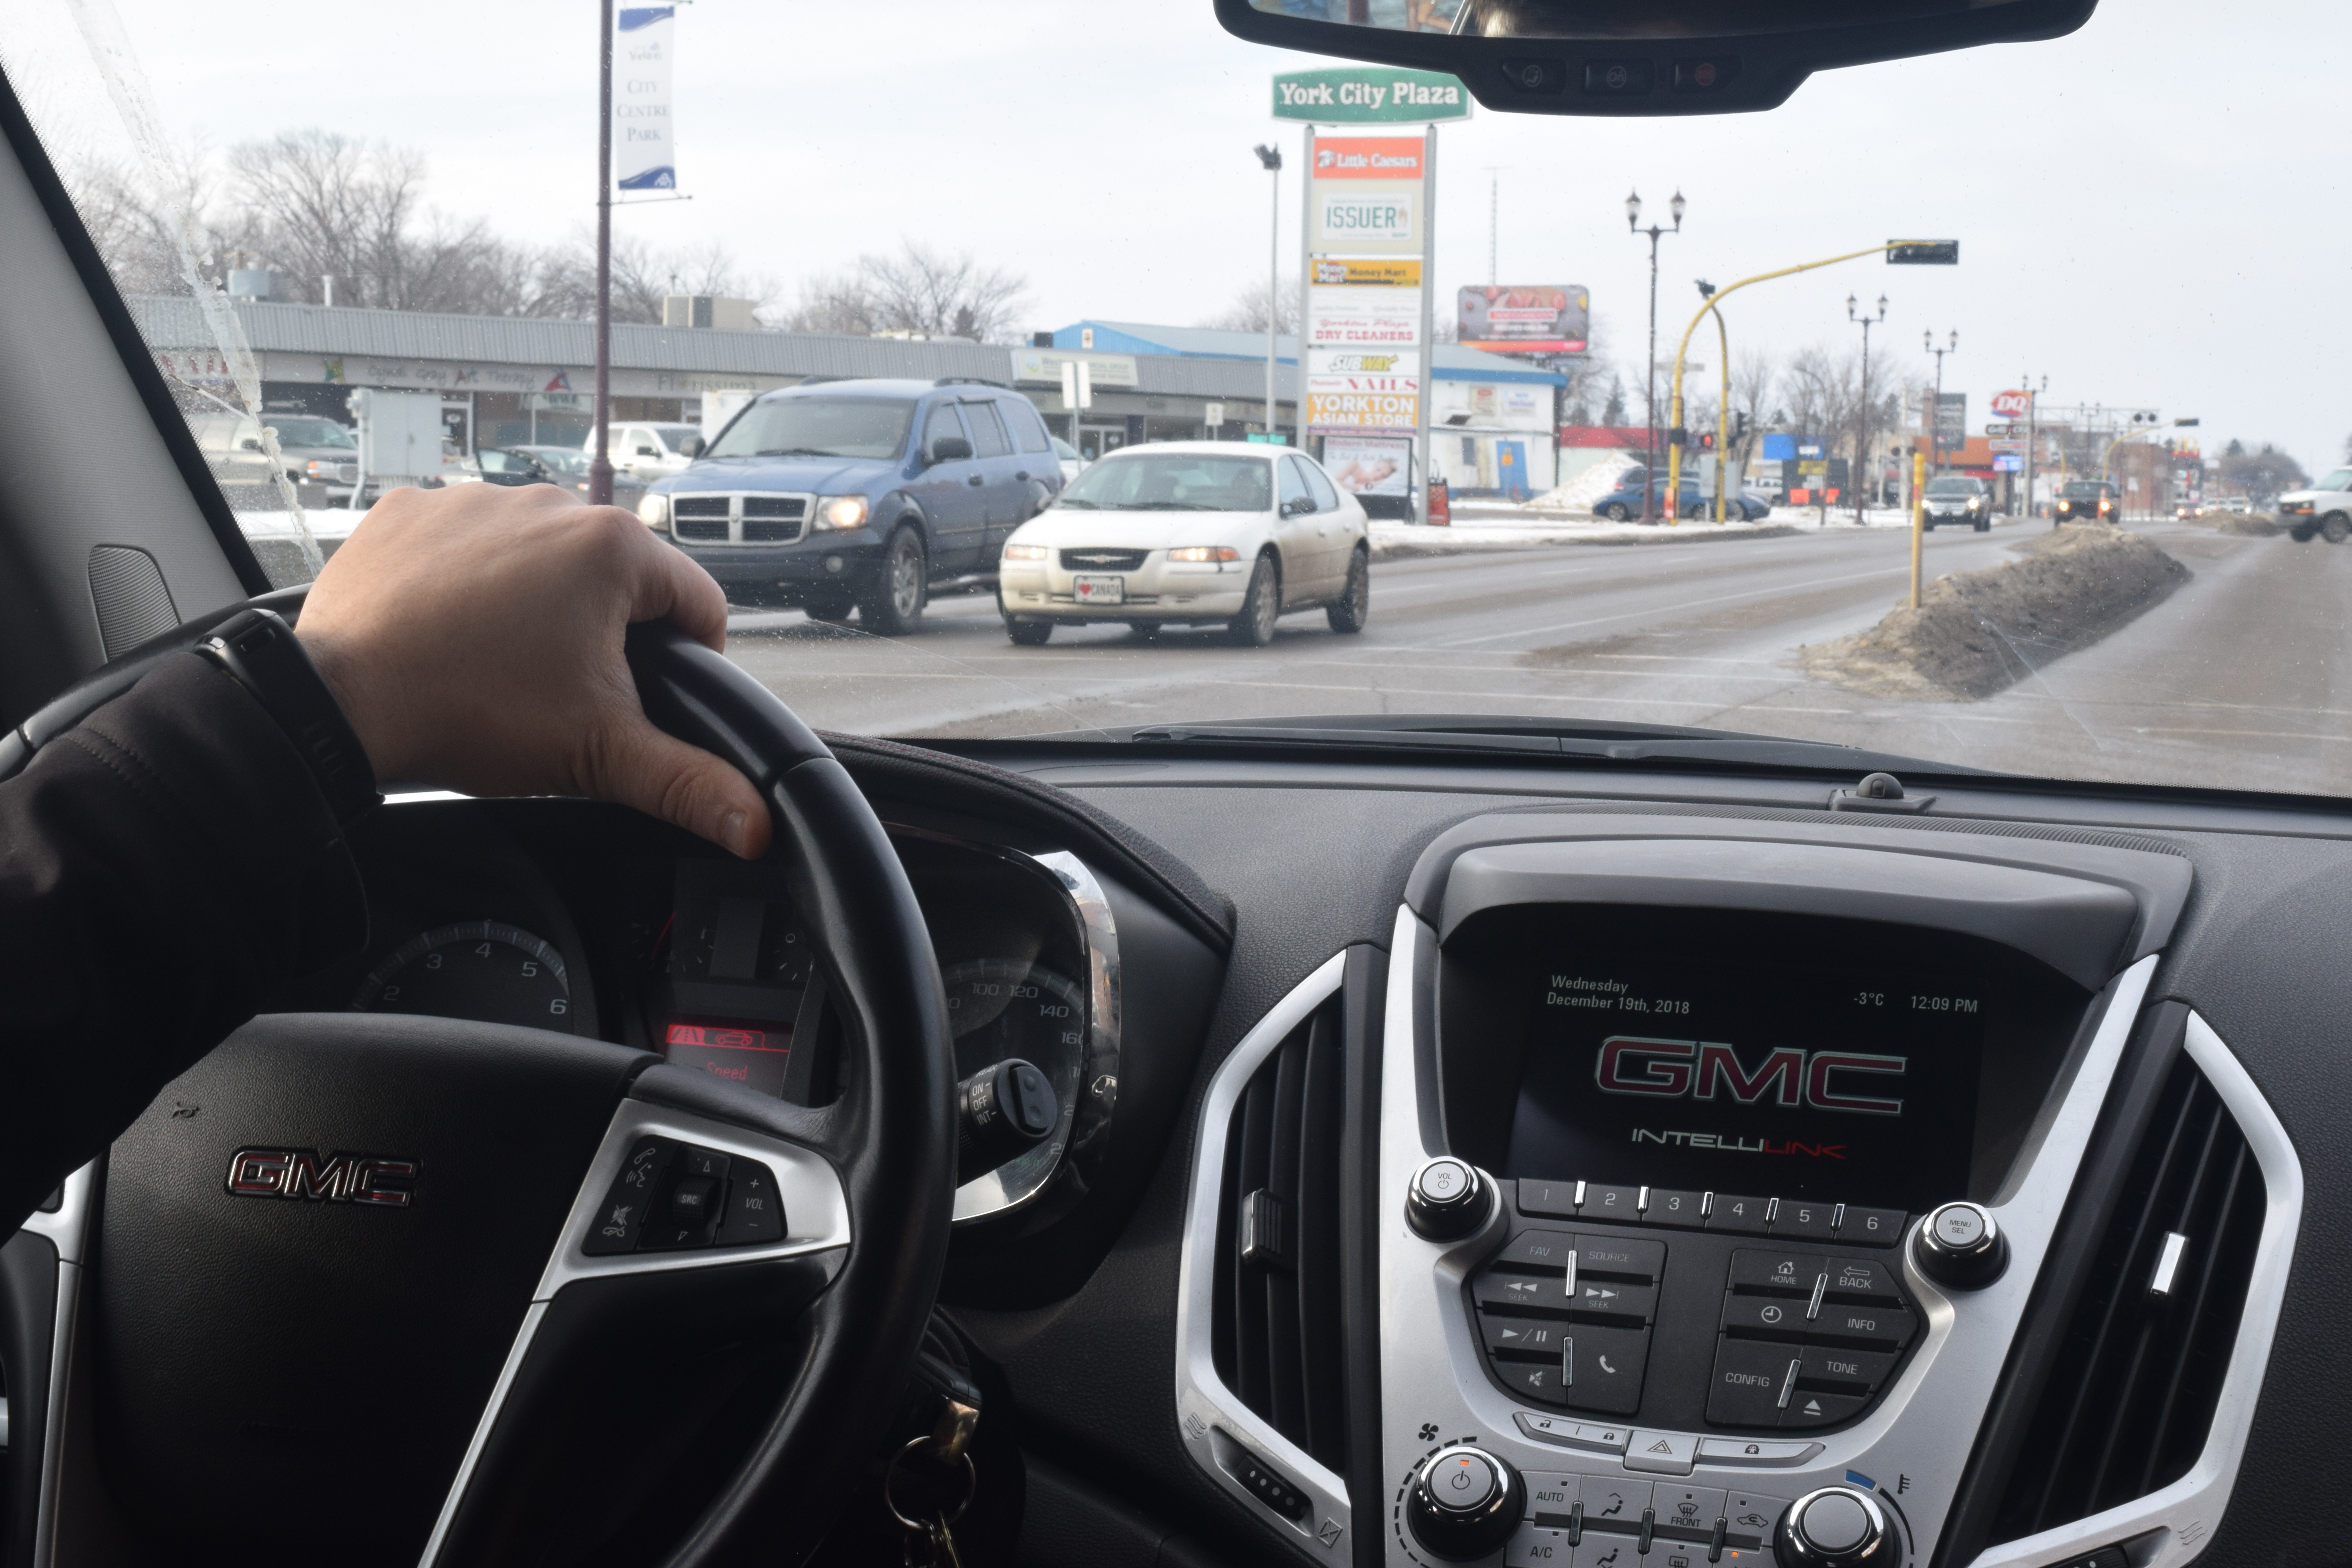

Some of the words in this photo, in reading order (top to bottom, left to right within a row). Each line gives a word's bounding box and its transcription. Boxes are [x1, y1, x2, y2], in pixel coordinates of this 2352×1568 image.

[1279, 82, 1334, 105] York
[1339, 82, 1387, 109] City
[1392, 82, 1460, 105] Plaza
[1336, 153, 1368, 168] Little
[1371, 153, 1418, 168] Caesars
[1326, 206, 1397, 229] ISSUER
[1349, 268, 1382, 278] Money
[1315, 330, 1342, 340] DRY
[1346, 330, 1414, 341] CLEANERS
[1327, 352, 1400, 373] SUBWAY
[1347, 377, 1418, 390] NAILS
[1312, 395, 1415, 413] YORKTON
[1998, 396, 2027, 412] DQ
[1312, 412, 1360, 425] ASIAN
[1364, 414, 1414, 426] STORE
[1091, 584, 1120, 596] CANADA
[475, 943, 491, 958] 4
[426, 954, 443, 969] 3
[521, 962, 538, 977] 5
[972, 982, 1000, 996] 100
[1009, 984, 1039, 999] 120
[1551, 975, 1628, 995] Wednesday
[383, 985, 400, 1001] 2
[550, 998, 567, 1014] 6
[1546, 991, 1613, 1009] December
[1617, 995, 1651, 1014] 19th,
[1654, 998, 1690, 1015] 2018
[1853, 991, 1885, 1007] -3°C
[1909, 994, 1950, 1011] 12:09
[1954, 998, 1979, 1013] PM
[1040, 1004, 1069, 1018] 140
[1594, 1035, 1907, 1116] GMC
[972, 1082, 984, 1097] ON
[973, 1095, 987, 1111] OFF
[976, 1110, 992, 1126] INT
[227, 1149, 418, 1208] GMC
[681, 1194, 698, 1205] SRC
[1544, 1189, 1548, 1201] 1
[1605, 1192, 1617, 1206] 2
[745, 1197, 764, 1210] VOL
[1668, 1197, 1680, 1210] 3
[1732, 1202, 1744, 1216] 4
[1799, 1209, 1810, 1223] 5
[1867, 1217, 1878, 1230] 6
[1949, 1219, 1972, 1229] MENU
[1530, 1246, 1550, 1257] FAV
[1588, 1250, 1631, 1263] SOURCE
[1771, 1275, 1797, 1285] HOME
[1839, 1276, 1872, 1289] BACK
[1508, 1293, 1528, 1302] SEEK
[1588, 1299, 1609, 1309] SEEK
[1847, 1318, 1876, 1331] INFO
[1826, 1361, 1858, 1375] TONE
[1725, 1372, 1770, 1388] CONFIG
[1535, 1491, 1564, 1503] AUTO
[1670, 1515, 1701, 1528] FRONT
[1530, 1546, 1552, 1559] A/C
